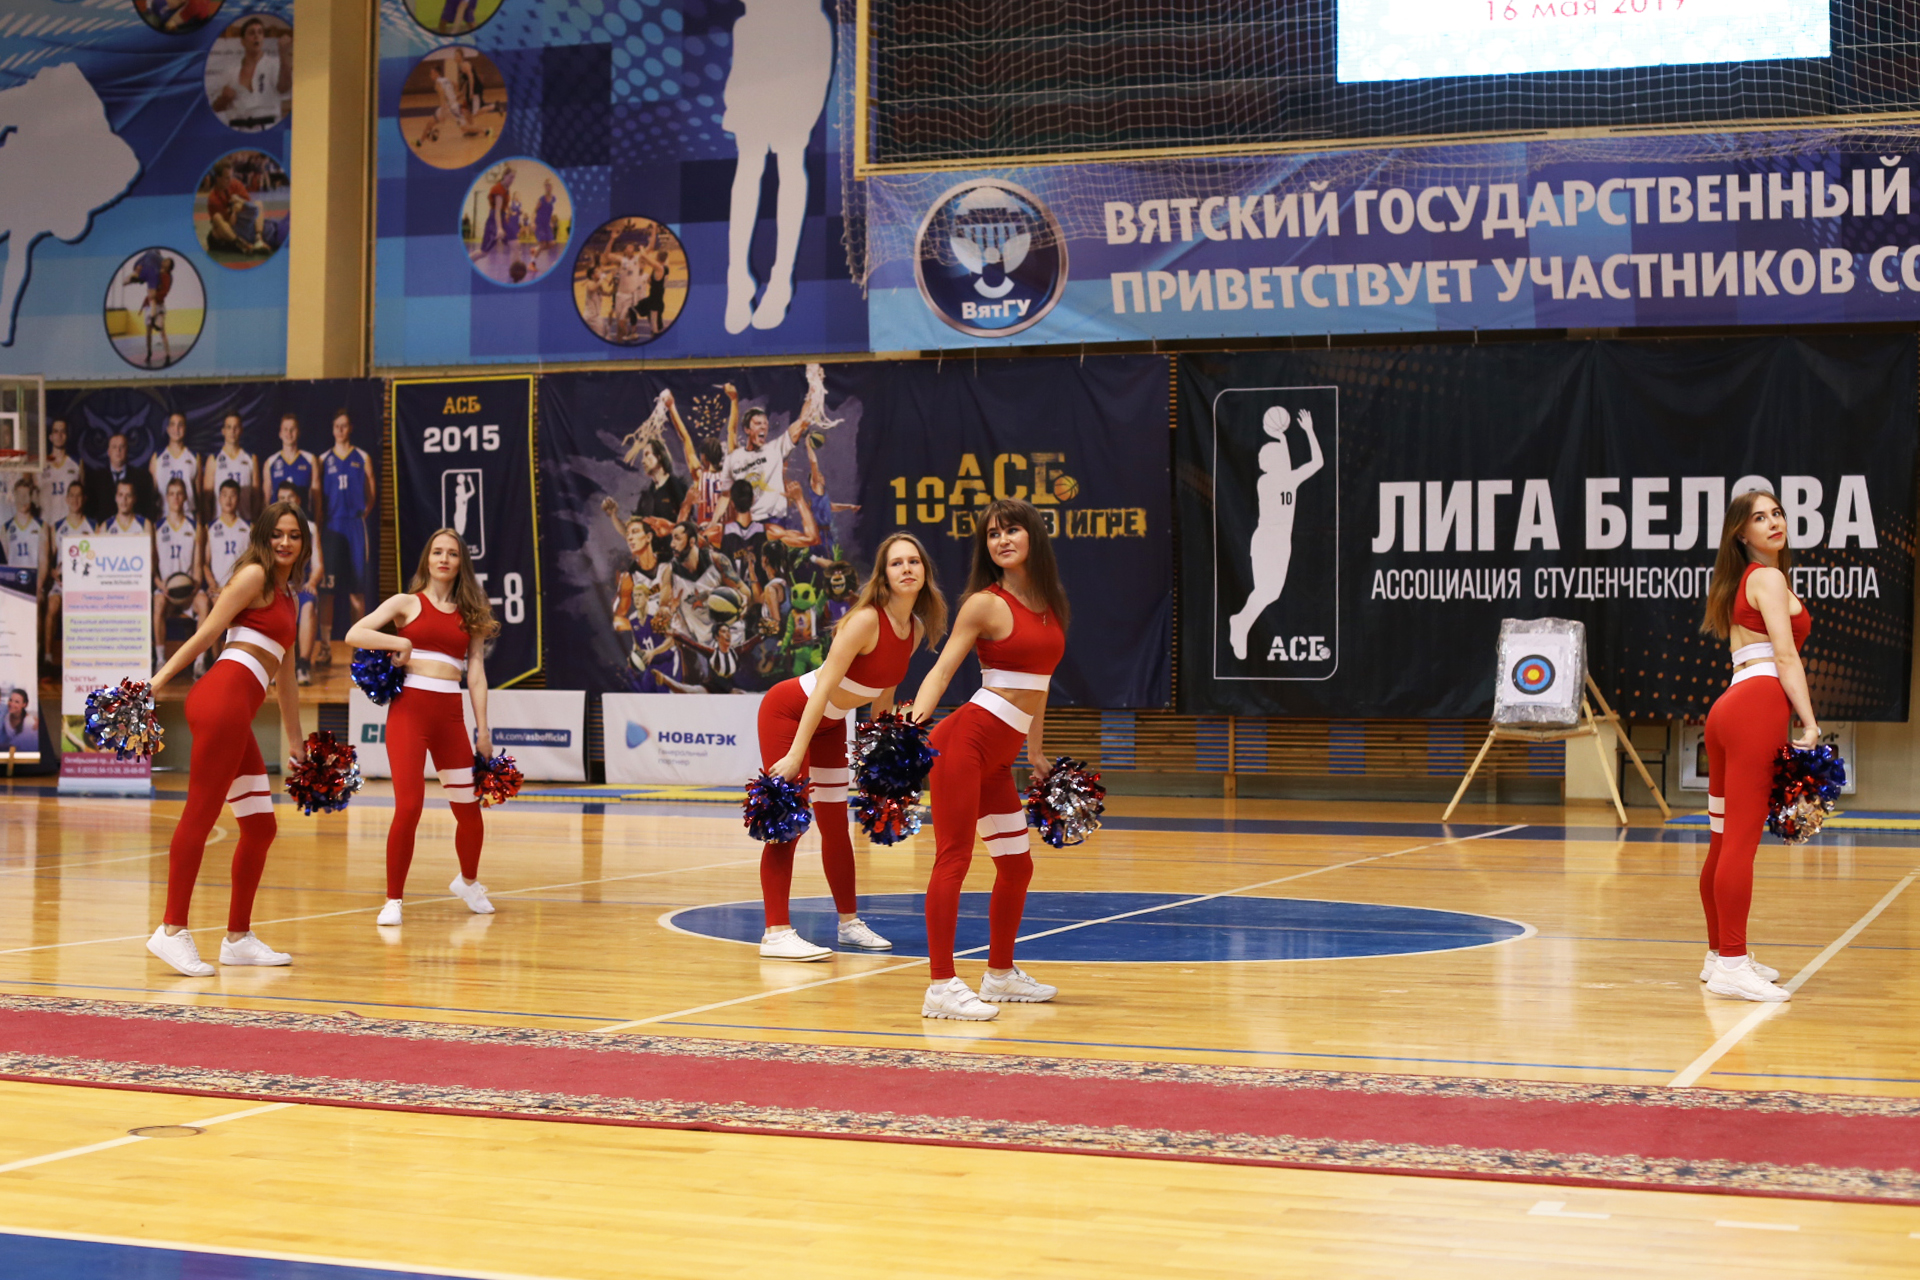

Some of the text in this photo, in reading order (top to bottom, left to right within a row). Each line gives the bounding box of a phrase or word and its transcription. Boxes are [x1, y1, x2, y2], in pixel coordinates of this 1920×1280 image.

[1488, 0, 1518, 20] 16
[1532, 1, 1597, 17] мая
[1104, 155, 1911, 245] ВЯТСКИЙ ГОСУДАРСТВЕННЫЙ
[1110, 259, 1478, 314] ПРИВЕТСТВУЕТ
[1491, 248, 1855, 302] УЧАСТНИКОВ
[961, 299, 1031, 320] ВятГУ
[442, 396, 482, 415] АСБ
[423, 425, 501, 453] 2015
[889, 476, 945, 525] 10
[949, 452, 1079, 506] АСБ
[1279, 491, 1293, 506] 10
[1068, 509, 1145, 539] ИГРЕ
[1371, 474, 1879, 554] ЛИГА БЕЛВА
[95, 556, 144, 572] ЧУДО
[1371, 568, 1522, 603] АССОЦИАЦИЯ
[1788, 566, 1880, 599] ЕТБОЛА
[1267, 635, 1332, 662] АСБ
[658, 731, 737, 746] НОВАТЭК
